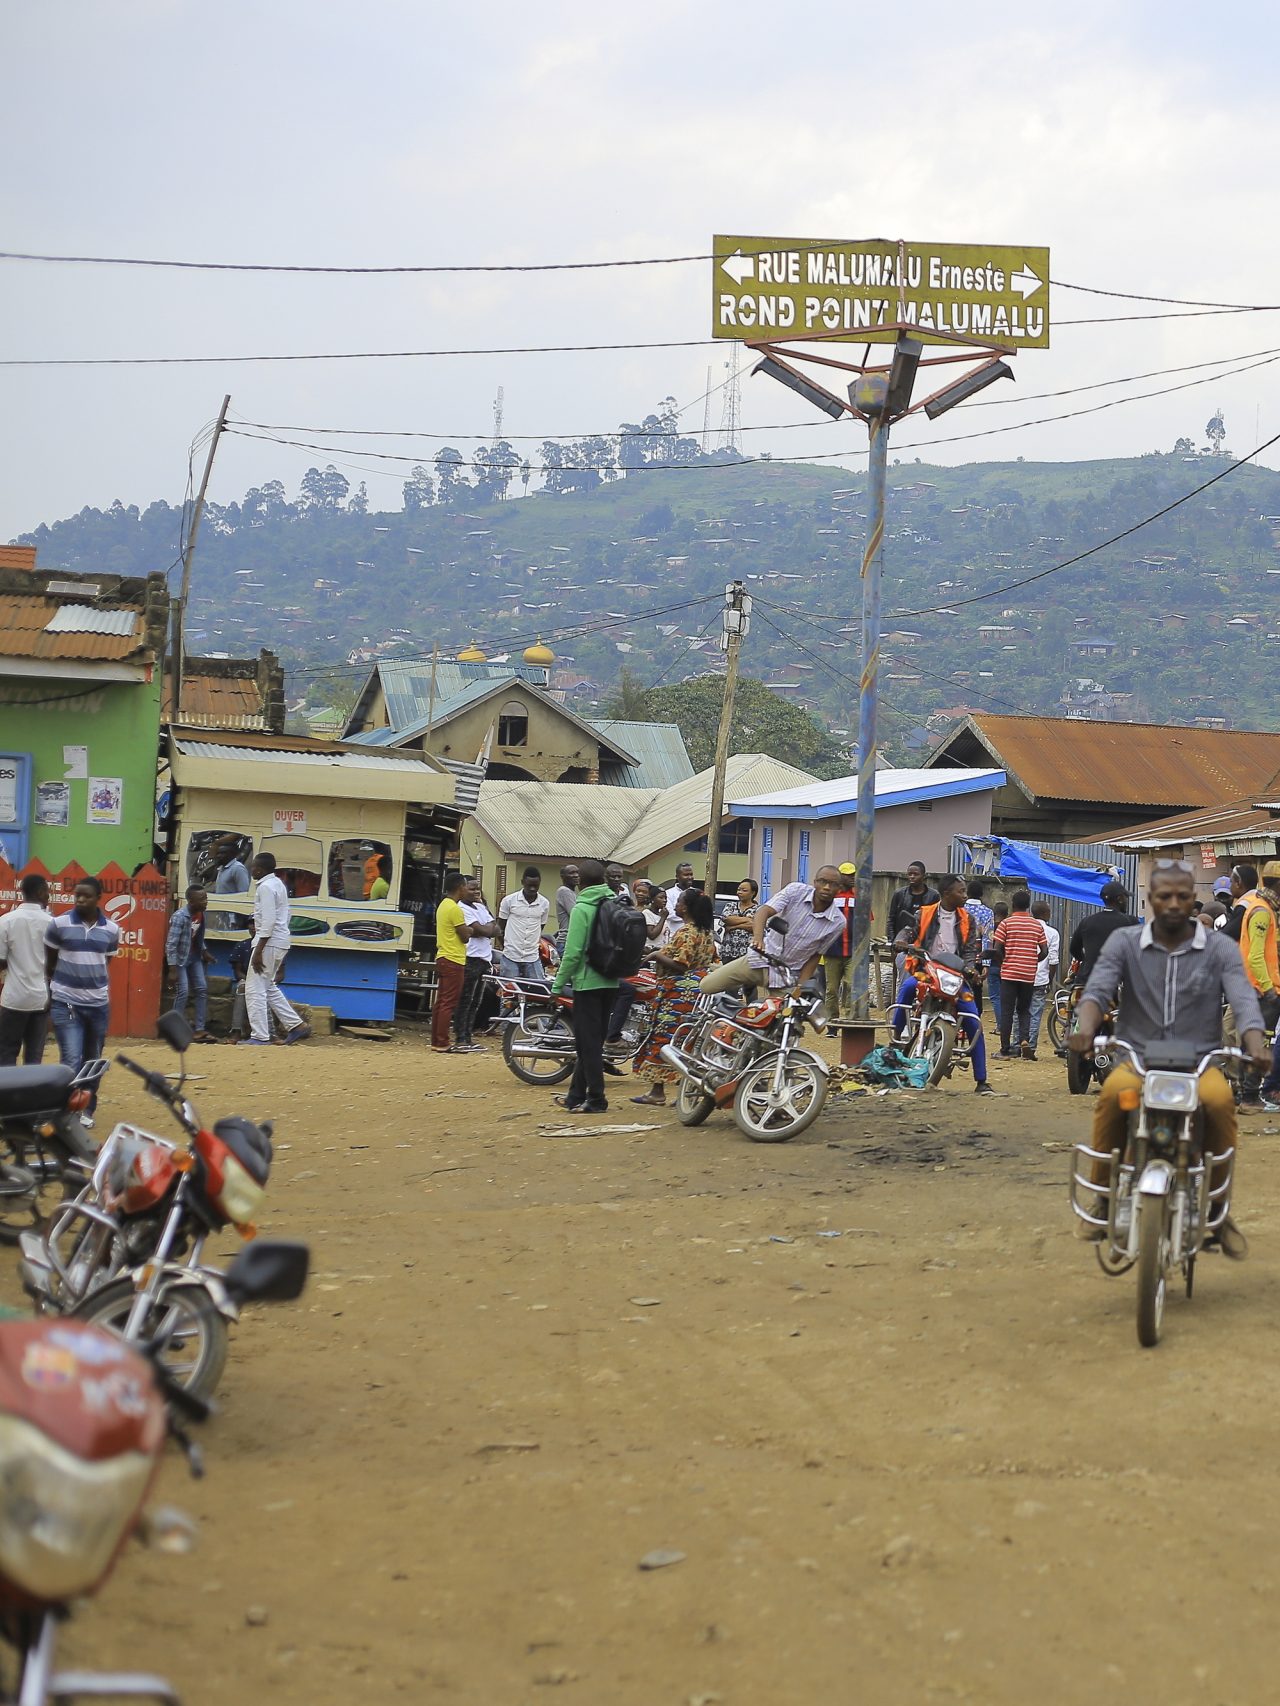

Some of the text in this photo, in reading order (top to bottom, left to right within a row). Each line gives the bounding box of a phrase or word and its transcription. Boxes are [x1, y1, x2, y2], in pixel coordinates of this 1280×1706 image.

[758, 251, 800, 284] RUE
[807, 252, 921, 288] MALUMALU
[719, 294, 1044, 338] ROND POINT MALUMALU
[275, 810, 304, 821] OUVER
[141, 897, 165, 912] 100$
[118, 927, 144, 945] tel
[117, 947, 150, 962] oney
